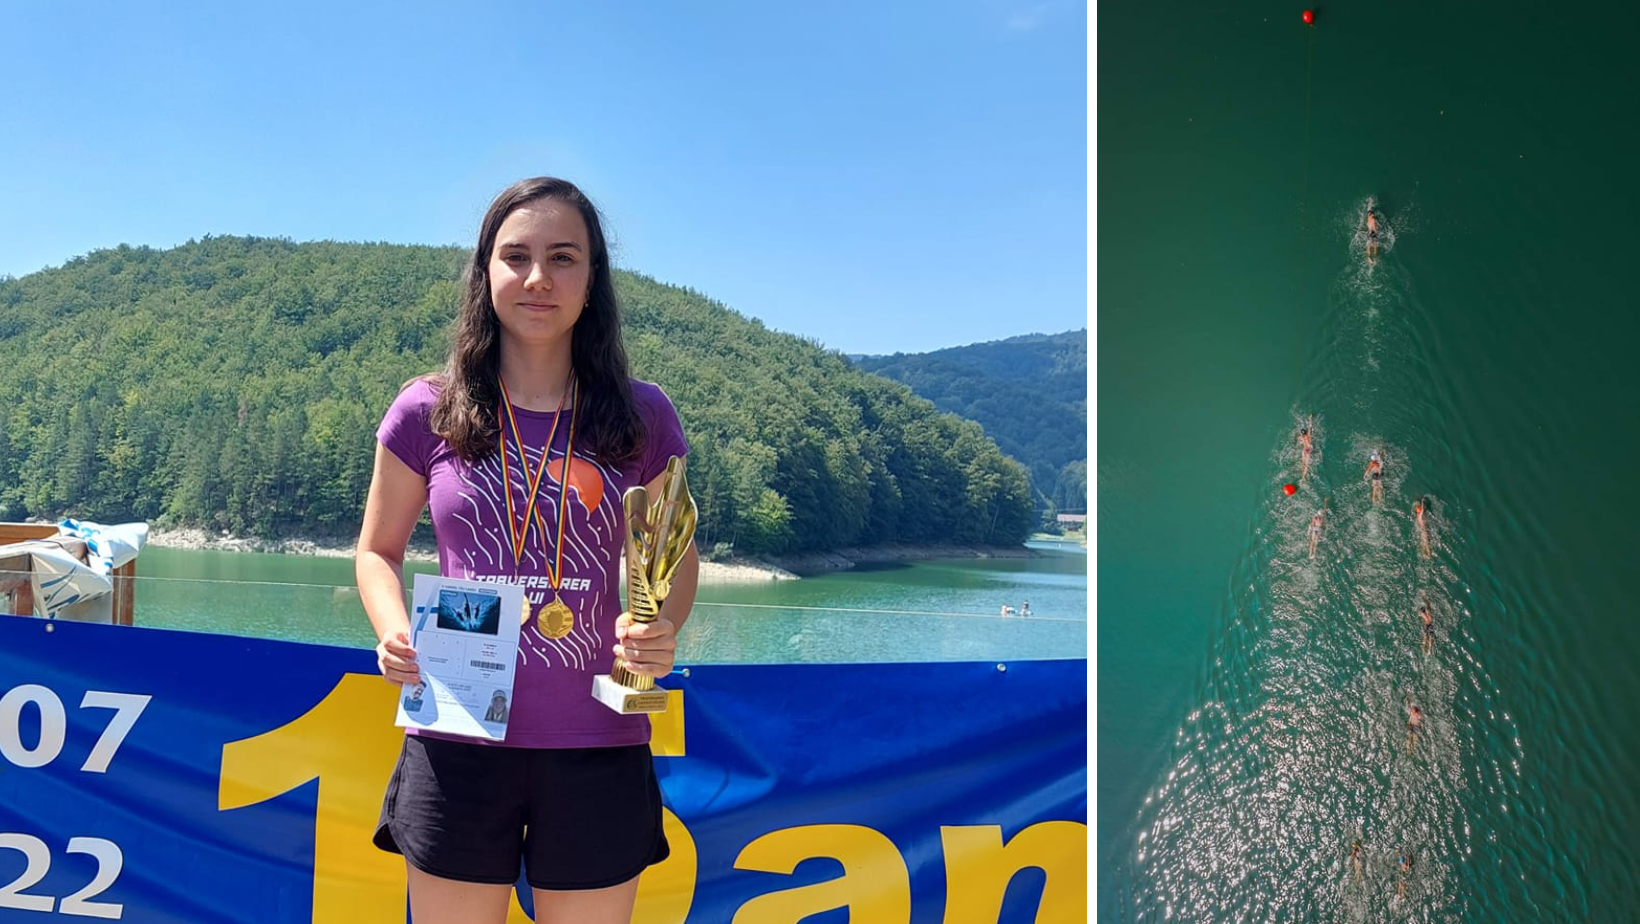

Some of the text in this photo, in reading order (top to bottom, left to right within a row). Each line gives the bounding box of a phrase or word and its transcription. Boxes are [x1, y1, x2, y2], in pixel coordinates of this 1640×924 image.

[476, 575, 591, 591] TRAVERSREA
[0, 684, 153, 773] 07
[0, 833, 123, 919] 22
